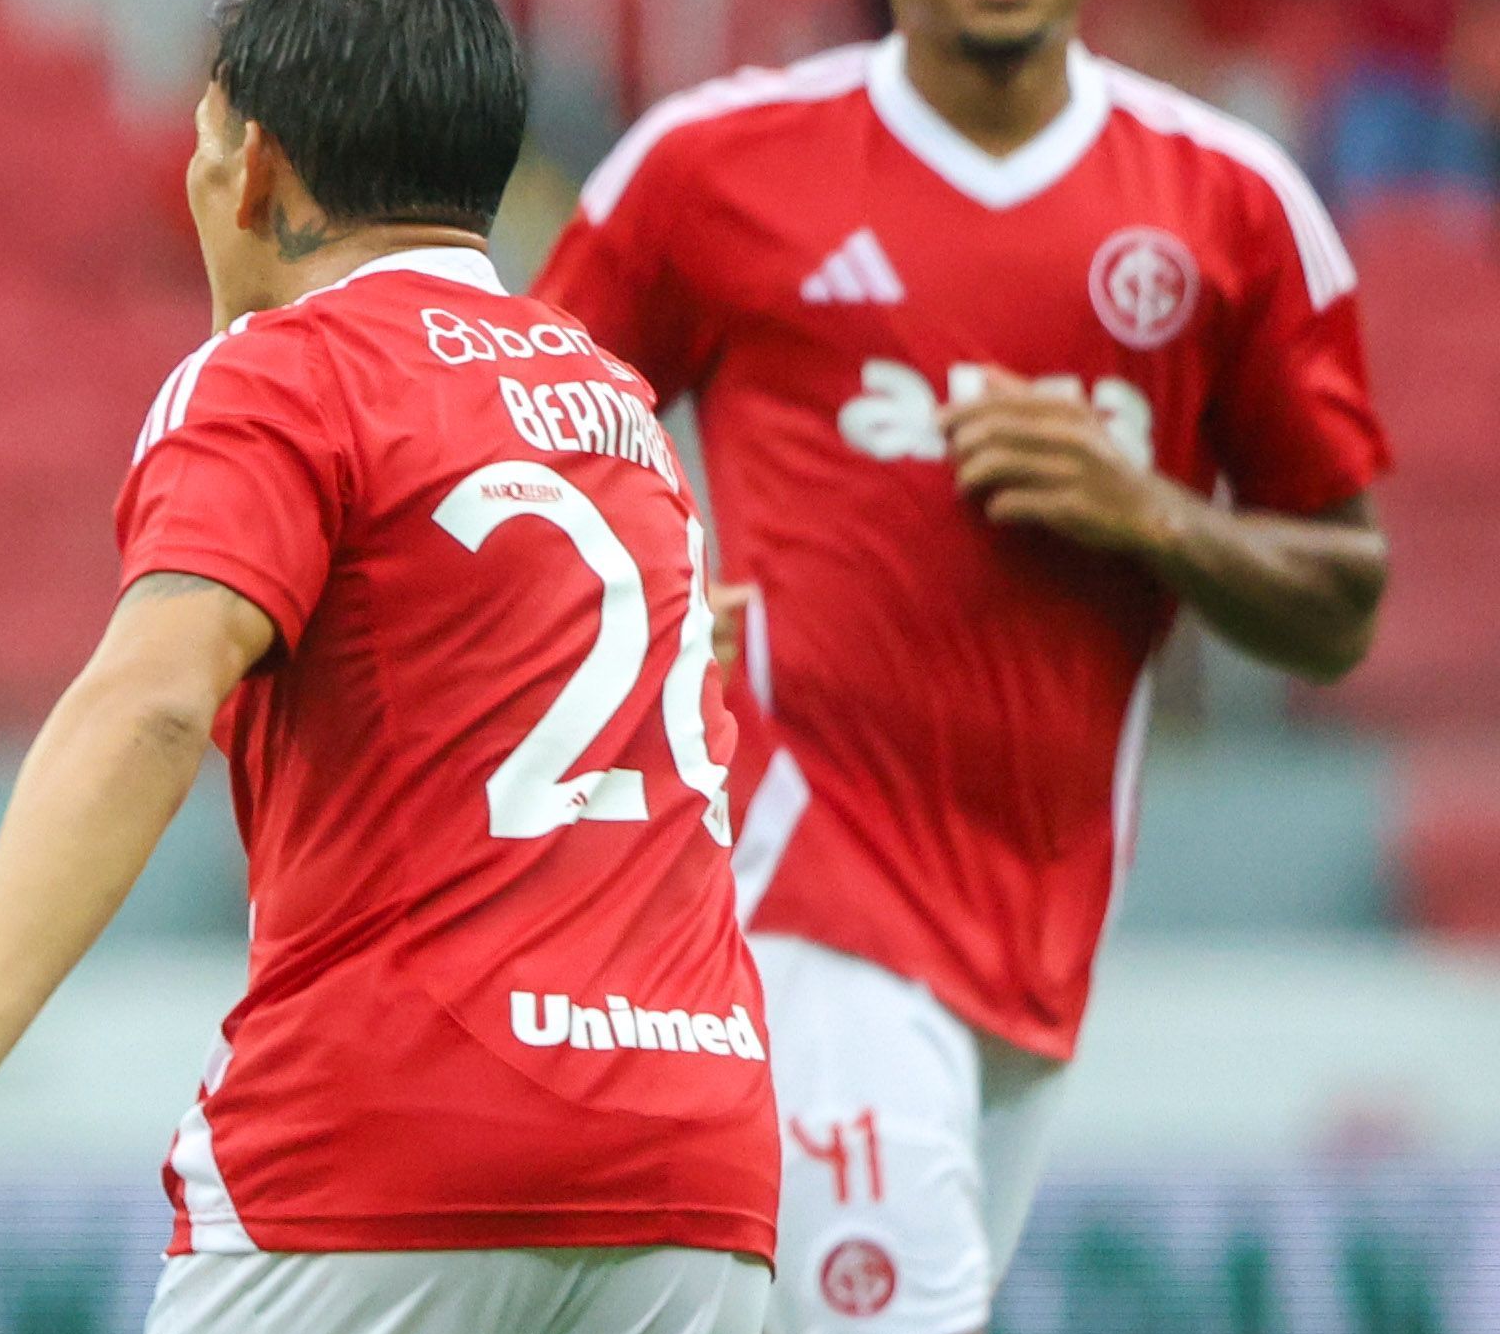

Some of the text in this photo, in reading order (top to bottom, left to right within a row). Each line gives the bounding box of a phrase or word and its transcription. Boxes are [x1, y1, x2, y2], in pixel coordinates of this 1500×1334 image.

[499, 375, 679, 494] BERNA
[837, 359, 1154, 473] aa
[510, 990, 766, 1061] Unimed
[789, 1106, 884, 1205] 41
